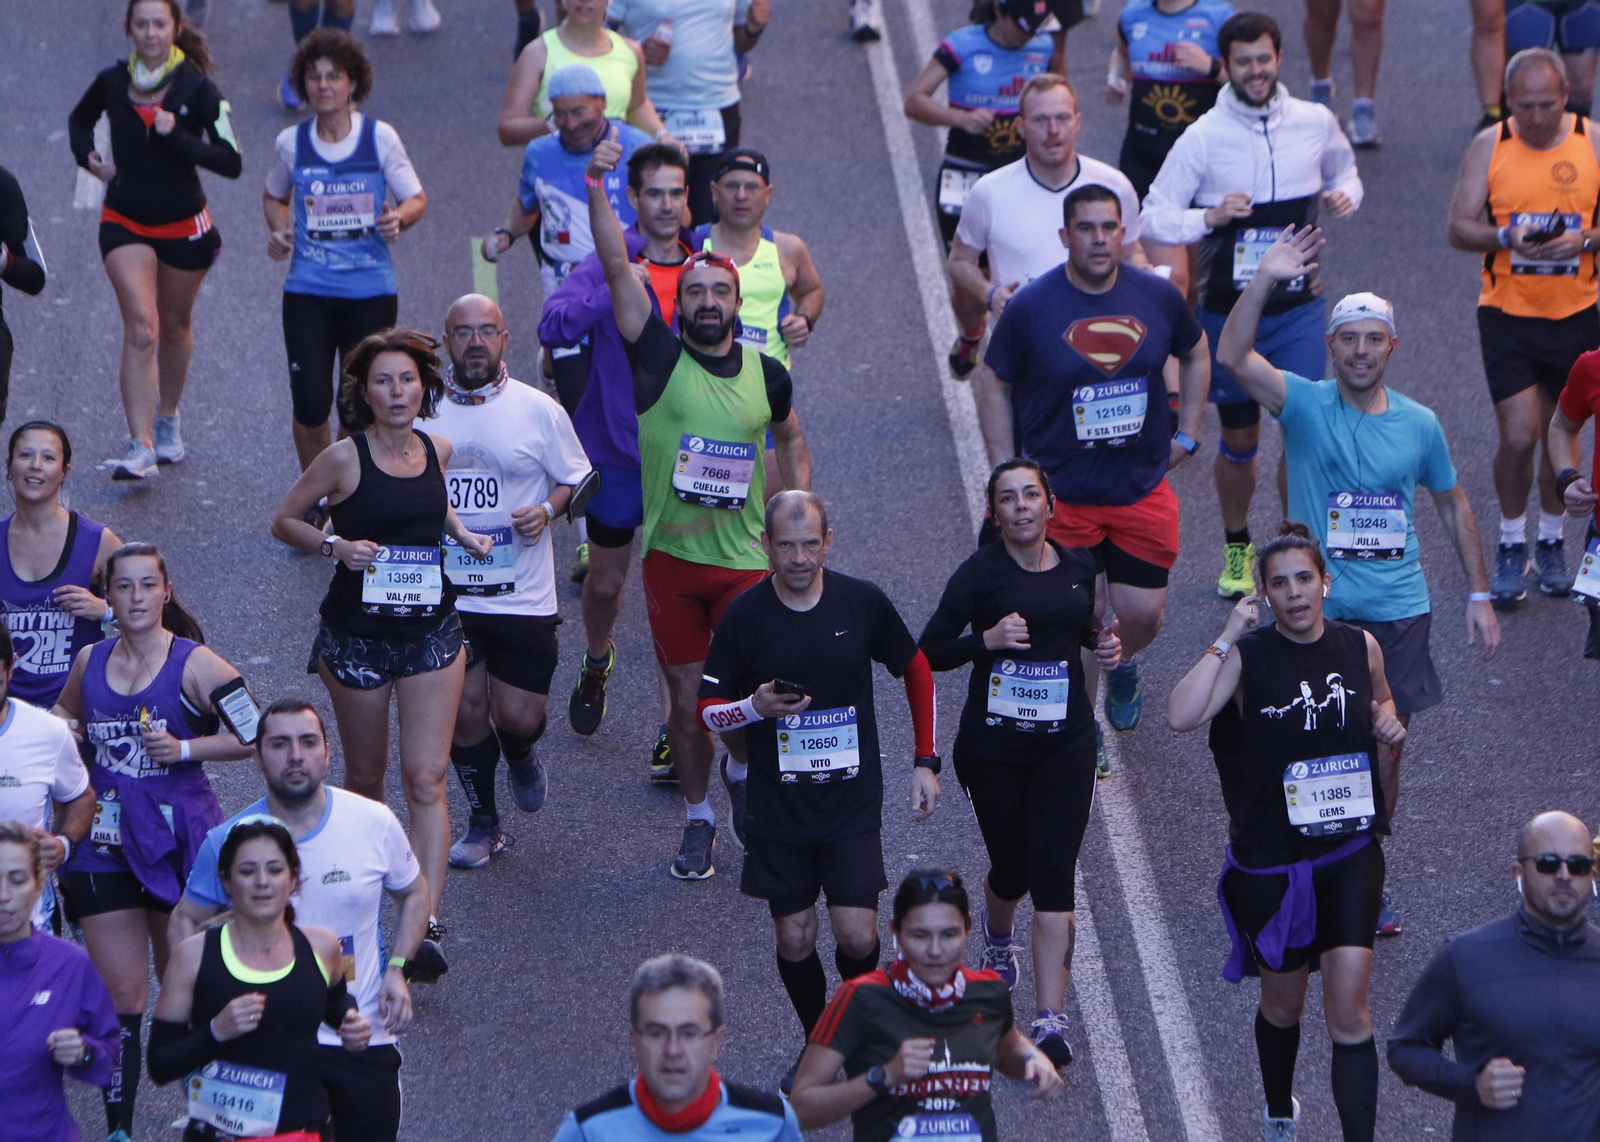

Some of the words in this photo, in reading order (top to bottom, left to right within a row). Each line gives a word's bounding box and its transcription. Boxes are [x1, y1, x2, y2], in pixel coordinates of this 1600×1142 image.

[326, 182, 365, 193] ZURICH
[317, 218, 362, 227] ELISABETTA
[1097, 382, 1139, 398] ZURICH
[1095, 405, 1131, 419] 12159
[1087, 429, 1093, 437] F
[1094, 427, 1110, 436] STA
[1112, 421, 1141, 434] TERESA
[706, 443, 748, 457] ZURICH
[701, 466, 731, 480] 7668
[449, 477, 499, 509] 3789
[693, 481, 730, 494] CUELLAS
[1354, 495, 1397, 507] ZURICH
[1349, 518, 1388, 529] 13248
[1355, 538, 1380, 546] JULIA
[392, 550, 433, 562] ZURICH
[387, 572, 423, 584] 13993
[467, 574, 484, 583] TTO
[38, 611, 76, 630] TWO
[39, 662, 70, 675] SEVILLA
[1018, 664, 1059, 677] ZURICH
[1011, 686, 1049, 700] 13493
[709, 706, 749, 729] ERGO
[803, 712, 848, 726] ZURICH
[1017, 706, 1038, 718] VITO
[799, 736, 839, 750] 12650
[810, 758, 831, 768] VITO
[1311, 758, 1360, 775] ZURICH
[138, 766, 170, 779] SEVILLA
[1311, 786, 1352, 802] 11385
[1319, 806, 1346, 818] GEMS
[93, 831, 111, 842] ANA
[219, 1066, 275, 1089] ZURICH
[211, 1092, 255, 1113] 13416
[215, 1114, 244, 1132] MARÍA
[919, 1119, 971, 1134] ZURICH
